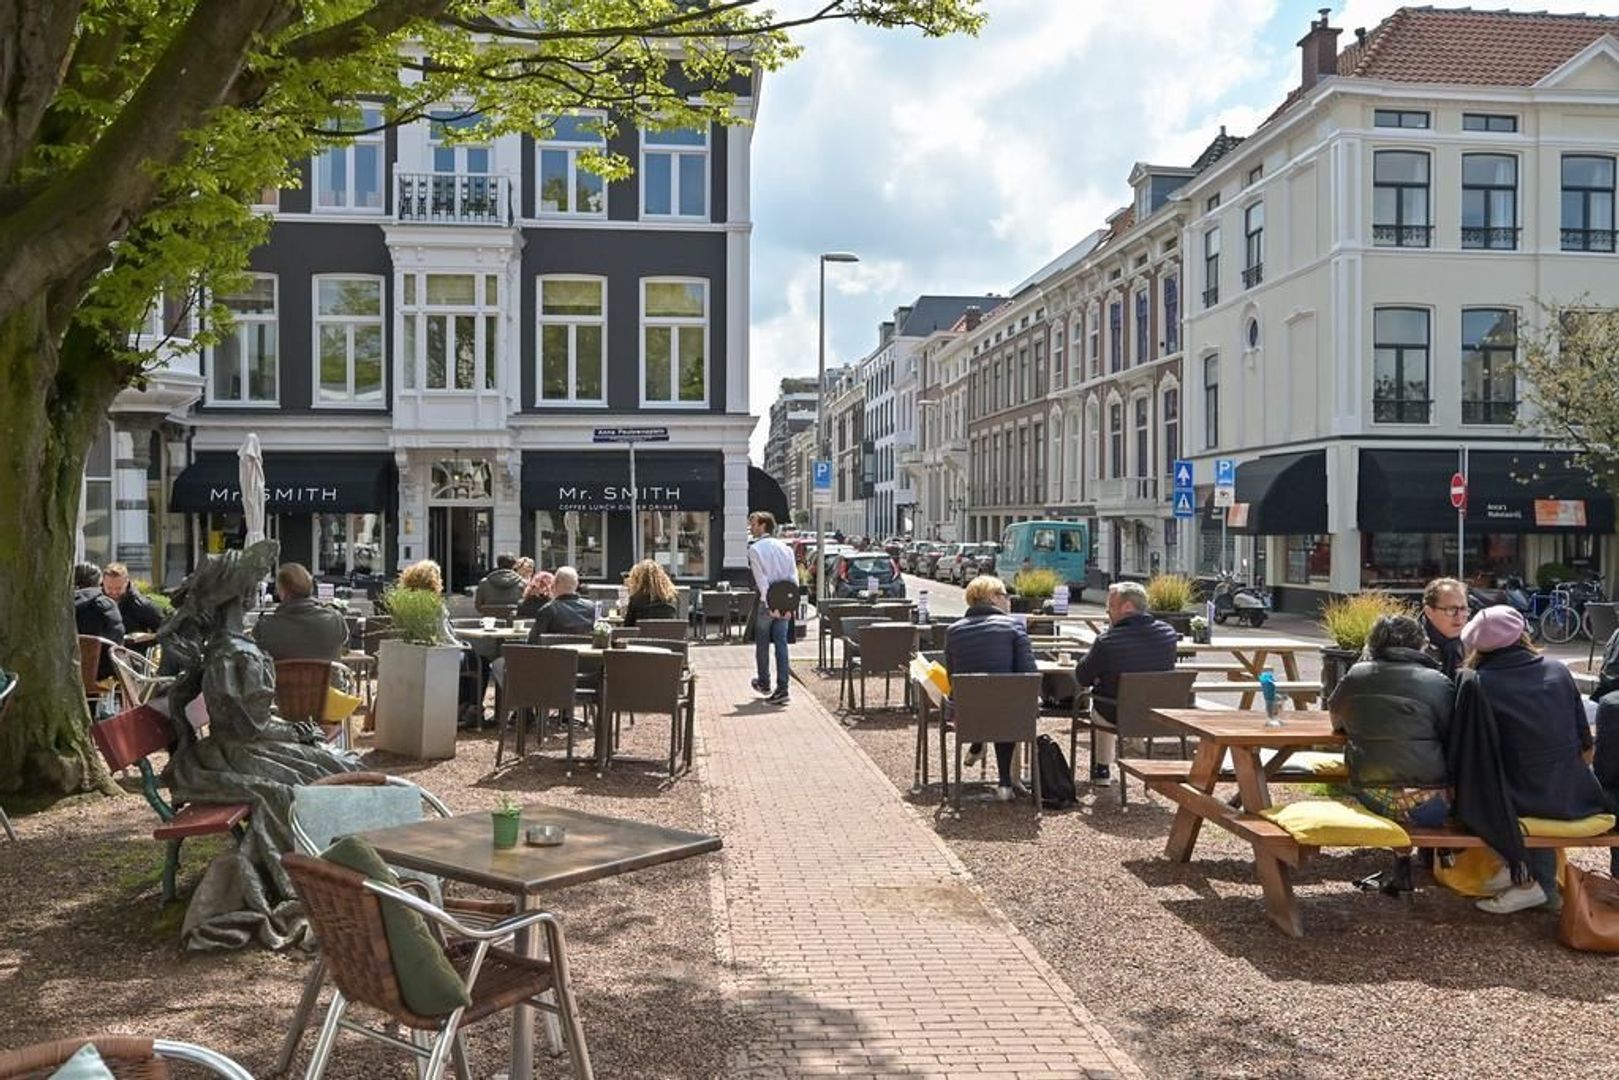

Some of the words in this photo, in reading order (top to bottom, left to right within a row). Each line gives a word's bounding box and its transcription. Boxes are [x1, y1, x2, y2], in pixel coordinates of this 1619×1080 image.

[818, 463, 828, 478] P
[1219, 461, 1230, 476] P
[559, 487, 592, 500] Mr.
[604, 486, 680, 500] SMITH
